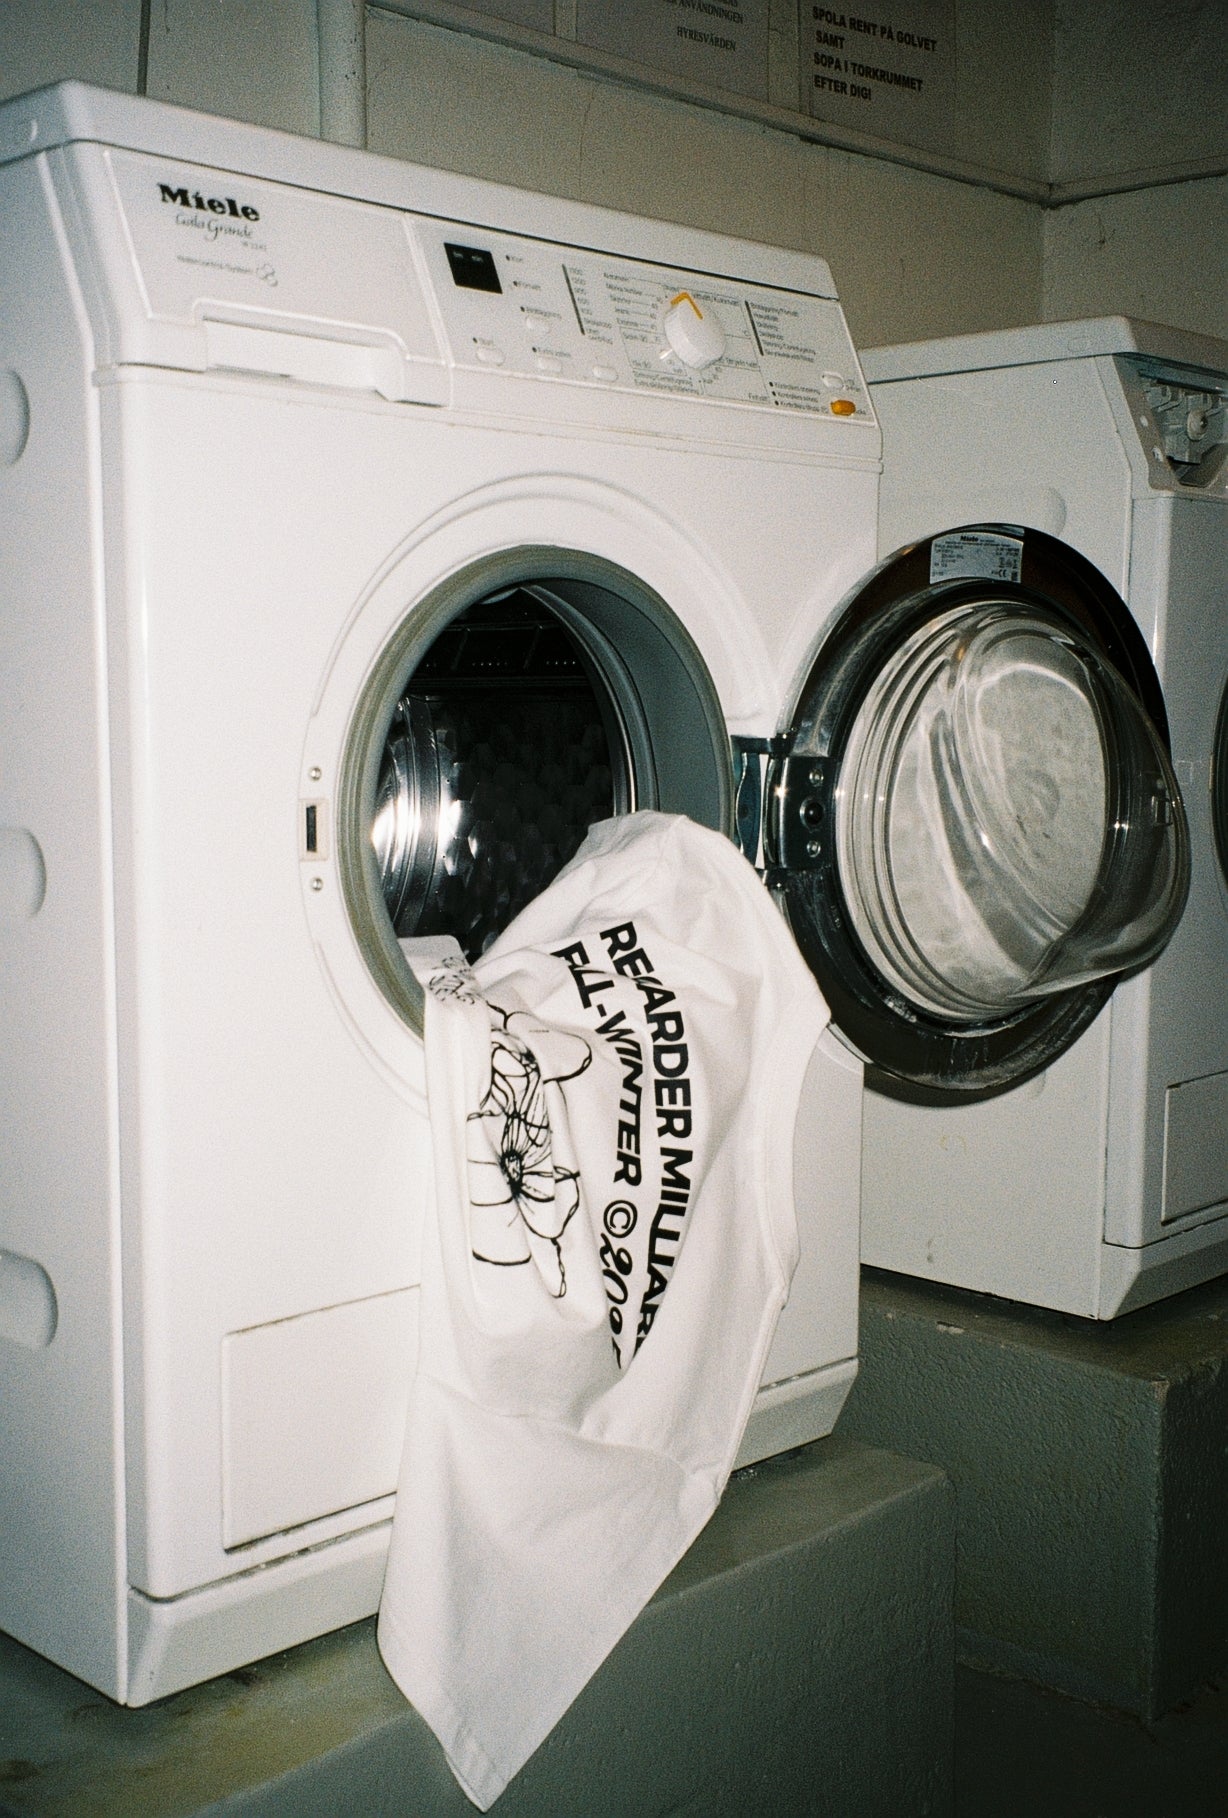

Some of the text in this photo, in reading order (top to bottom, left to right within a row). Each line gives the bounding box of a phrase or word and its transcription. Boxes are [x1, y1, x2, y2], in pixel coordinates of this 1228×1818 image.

[676, 26, 736, 51] HYRESVÄRDEN
[812, 5, 937, 52] SPOLA RENT PÅ GOLVET
[815, 30, 846, 49] SAMT
[813, 51, 924, 92] SOPA I TORKRUMMET
[814, 74, 872, 100] EFTER DIG!
[157, 182, 260, 222] Miele
[600, 920, 692, 1138] REARDER
[550, 940, 643, 1187] FLL-WINTER
